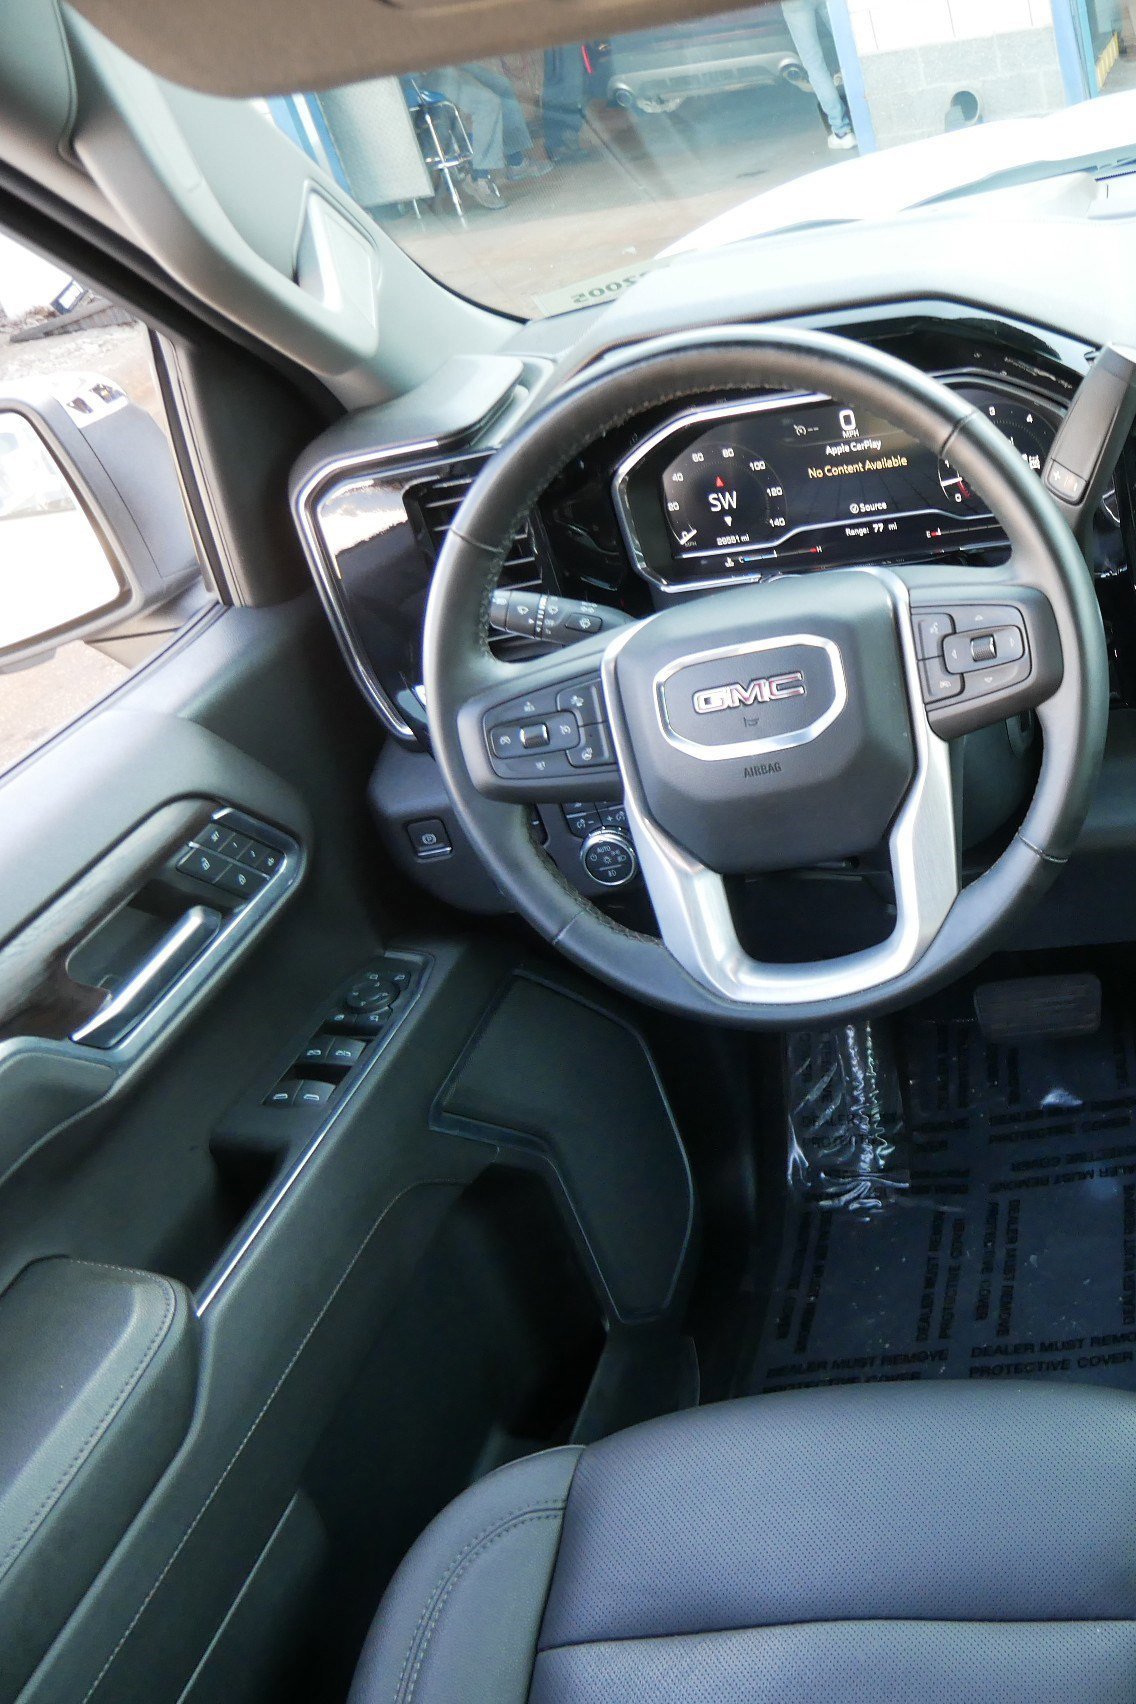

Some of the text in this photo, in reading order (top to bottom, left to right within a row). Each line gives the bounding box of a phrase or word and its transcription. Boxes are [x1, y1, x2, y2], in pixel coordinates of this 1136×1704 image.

[842, 429, 860, 439] MPH
[825, 438, 882, 456] Apple CarPlay
[749, 461, 766, 471] 100
[808, 455, 908, 479] No Content Available
[672, 473, 684, 482] 40
[708, 491, 737, 512] SW
[859, 501, 888, 512] Source
[769, 517, 786, 528] 140
[845, 522, 898, 537] Range: 77 mi
[693, 670, 807, 714] GMC
[744, 762, 782, 778] AIRBAG
[597, 845, 611, 853] AUTO
[970, 1342, 1035, 1358] DEALER
[1040, 1338, 1085, 1352] MUST
[969, 1351, 1134, 1378] PROTECTIVE COVER
